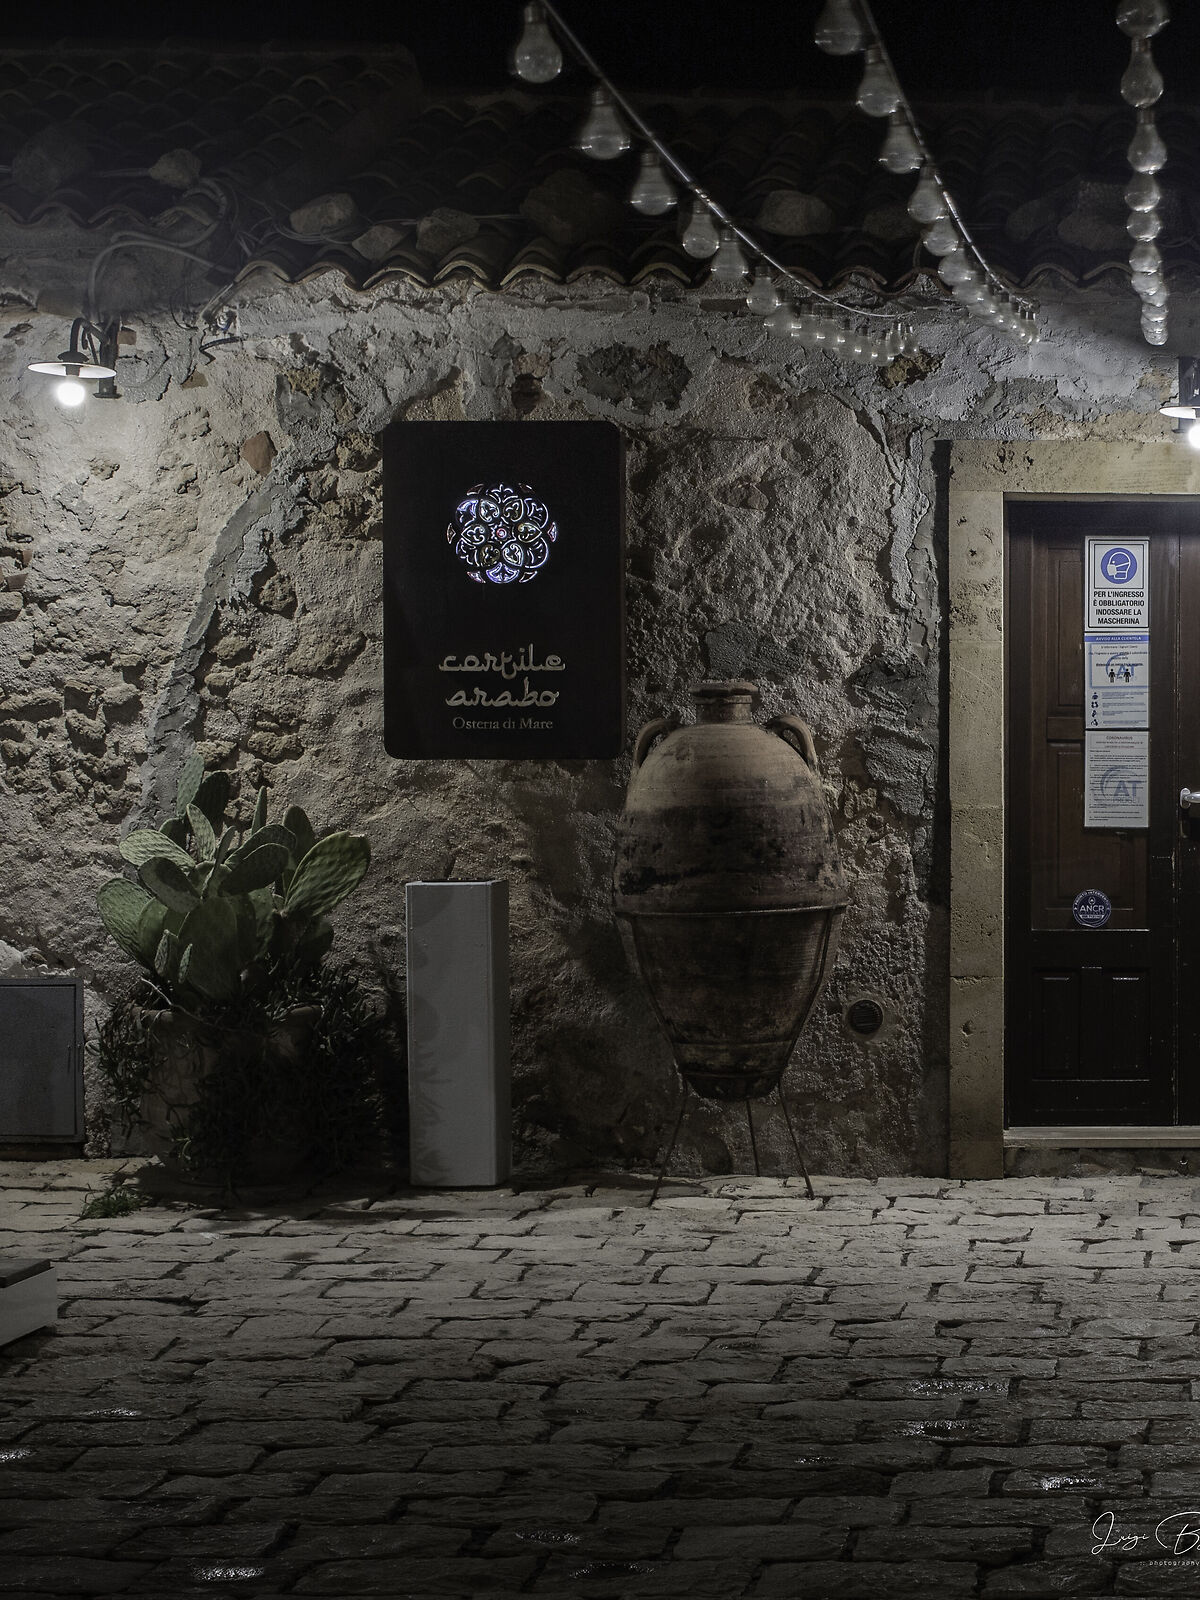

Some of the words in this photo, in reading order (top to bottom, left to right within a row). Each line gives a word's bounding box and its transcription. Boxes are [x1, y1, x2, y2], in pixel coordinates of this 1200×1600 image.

[1093, 599, 1097, 607] È
[1097, 617, 1140, 625] MASCHERINA
[439, 643, 566, 679] cortile
[445, 676, 560, 707] arabo
[452, 716, 500, 729] Osteria
[503, 717, 516, 729] di
[520, 717, 554, 729] Mare
[1080, 904, 1105, 912] ANCR
